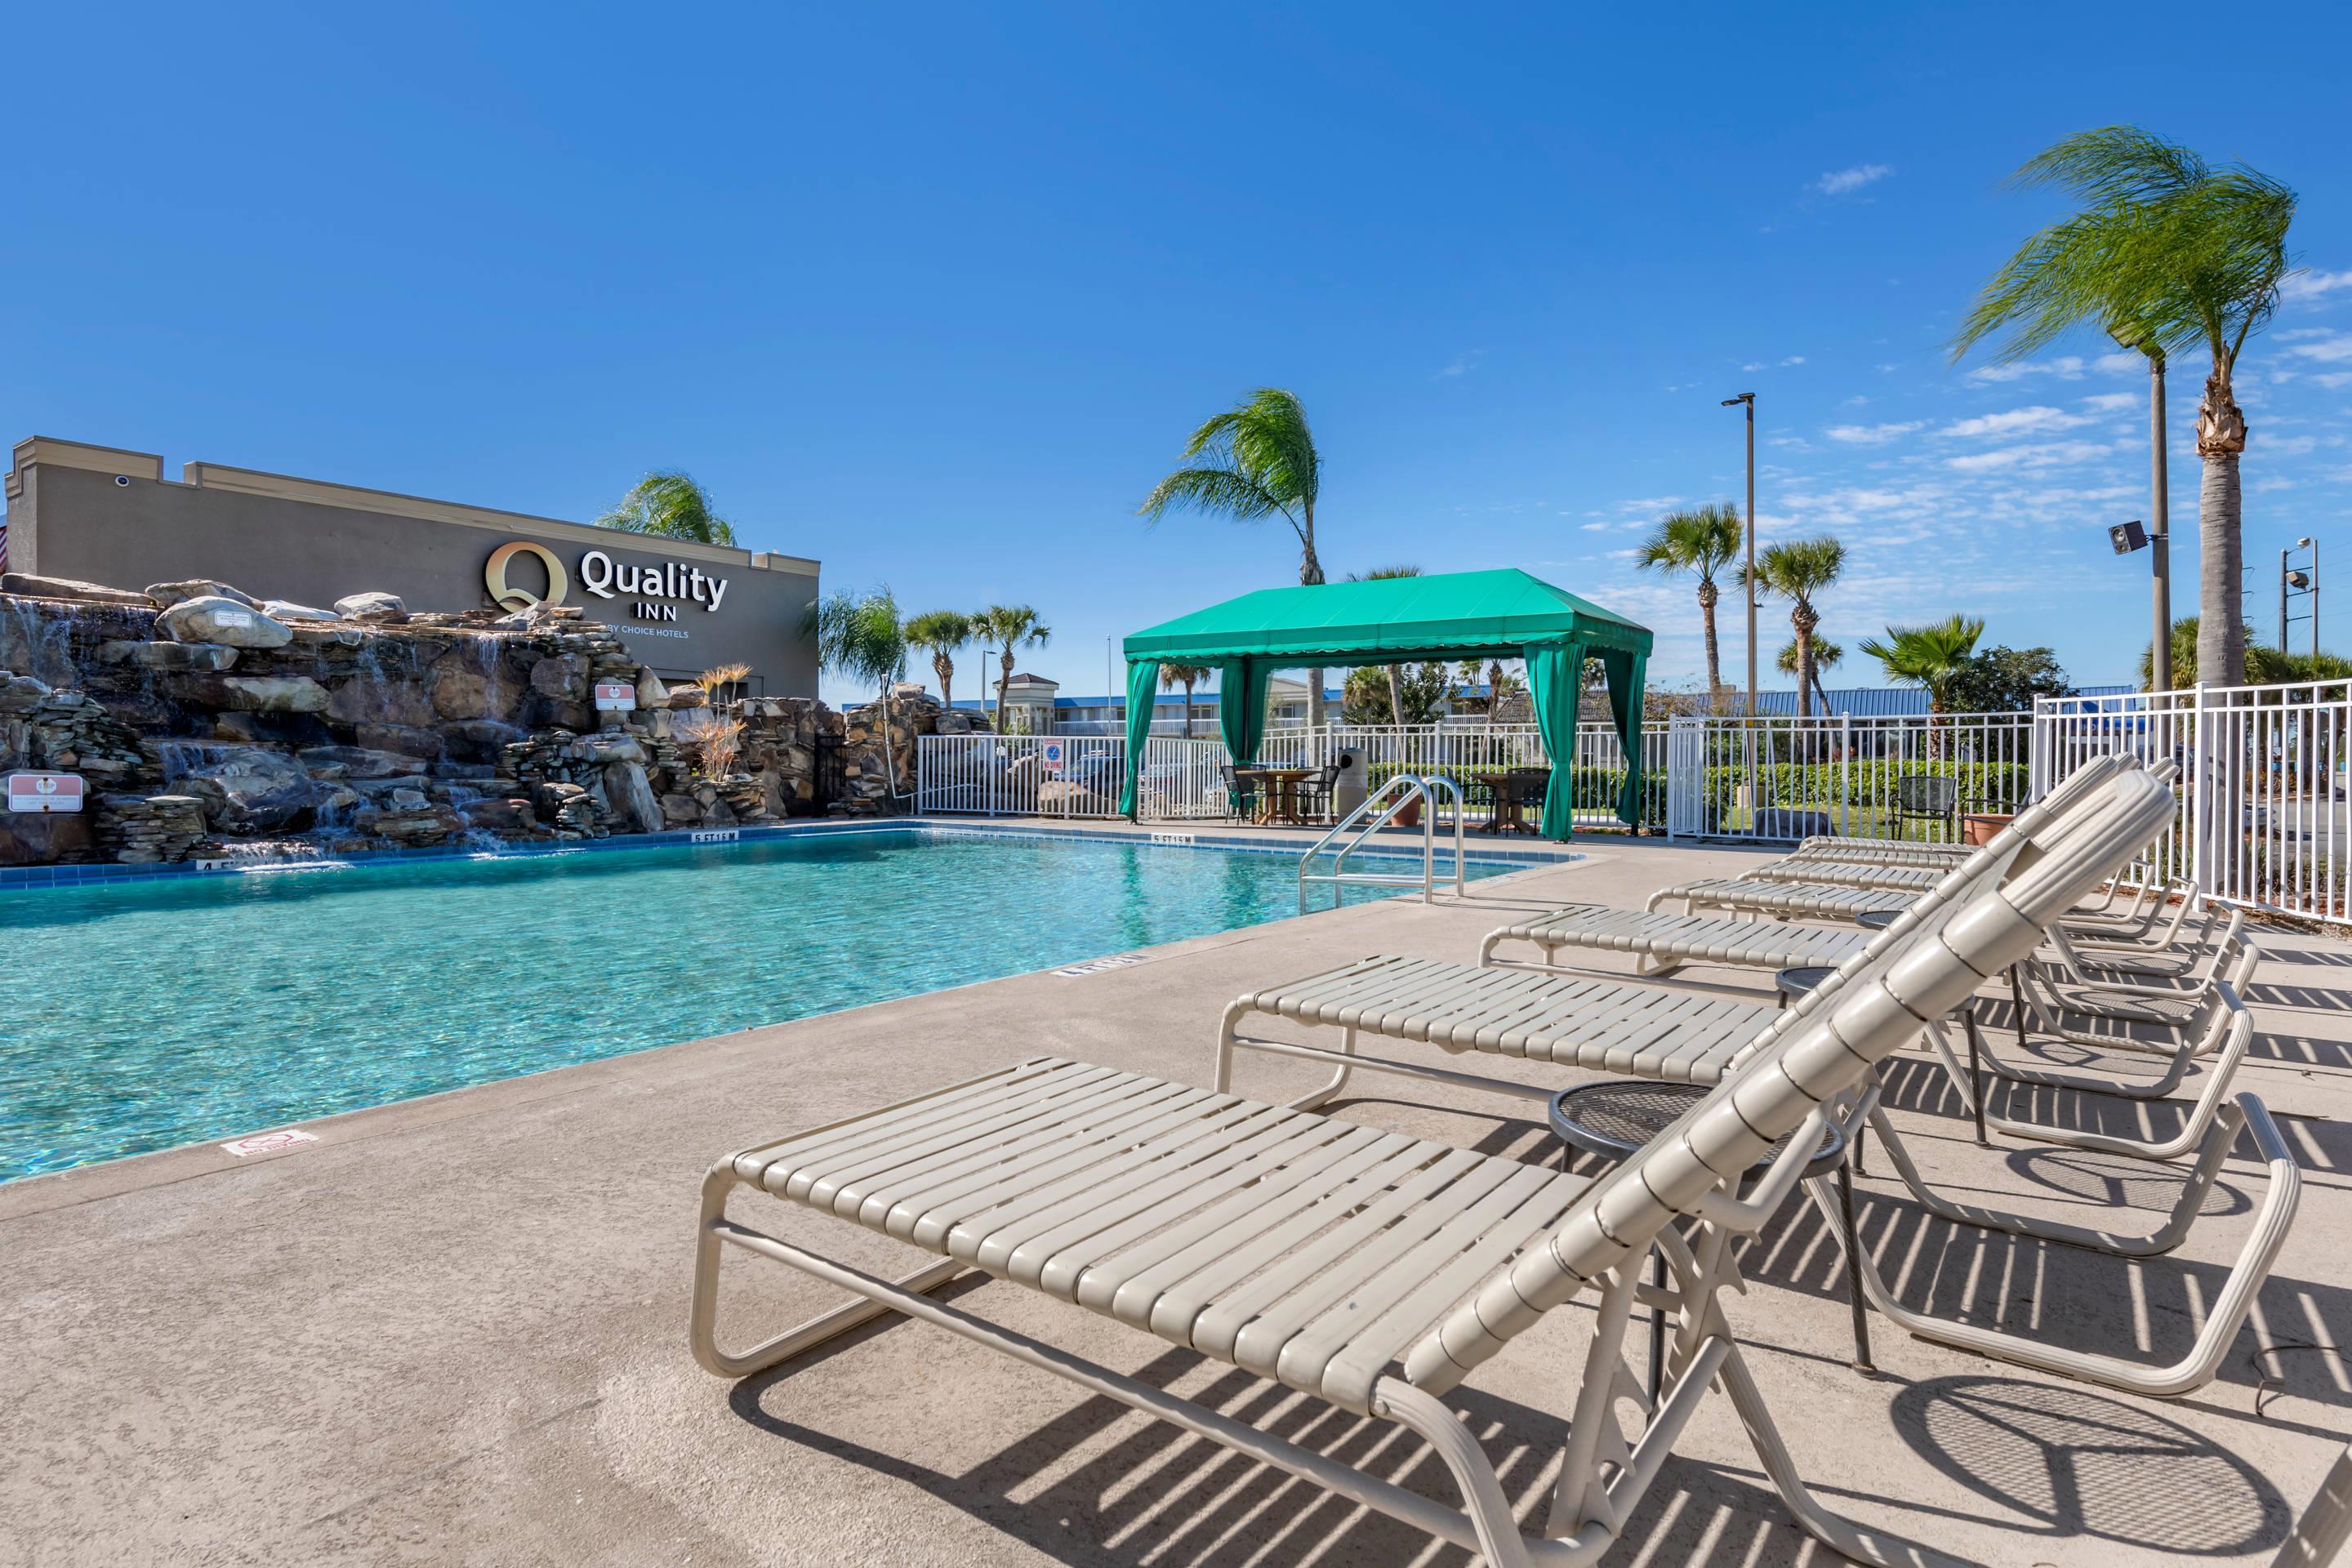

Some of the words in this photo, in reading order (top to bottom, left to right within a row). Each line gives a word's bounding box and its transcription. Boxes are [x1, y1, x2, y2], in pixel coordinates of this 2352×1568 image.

[581, 550, 728, 612] Quality
[638, 602, 677, 621] INN
[621, 626, 655, 636] CHOICE
[657, 629, 689, 639] HOTELS
[695, 834, 701, 842] 5
[728, 832, 735, 840] M
[1154, 835, 1160, 843] 5
